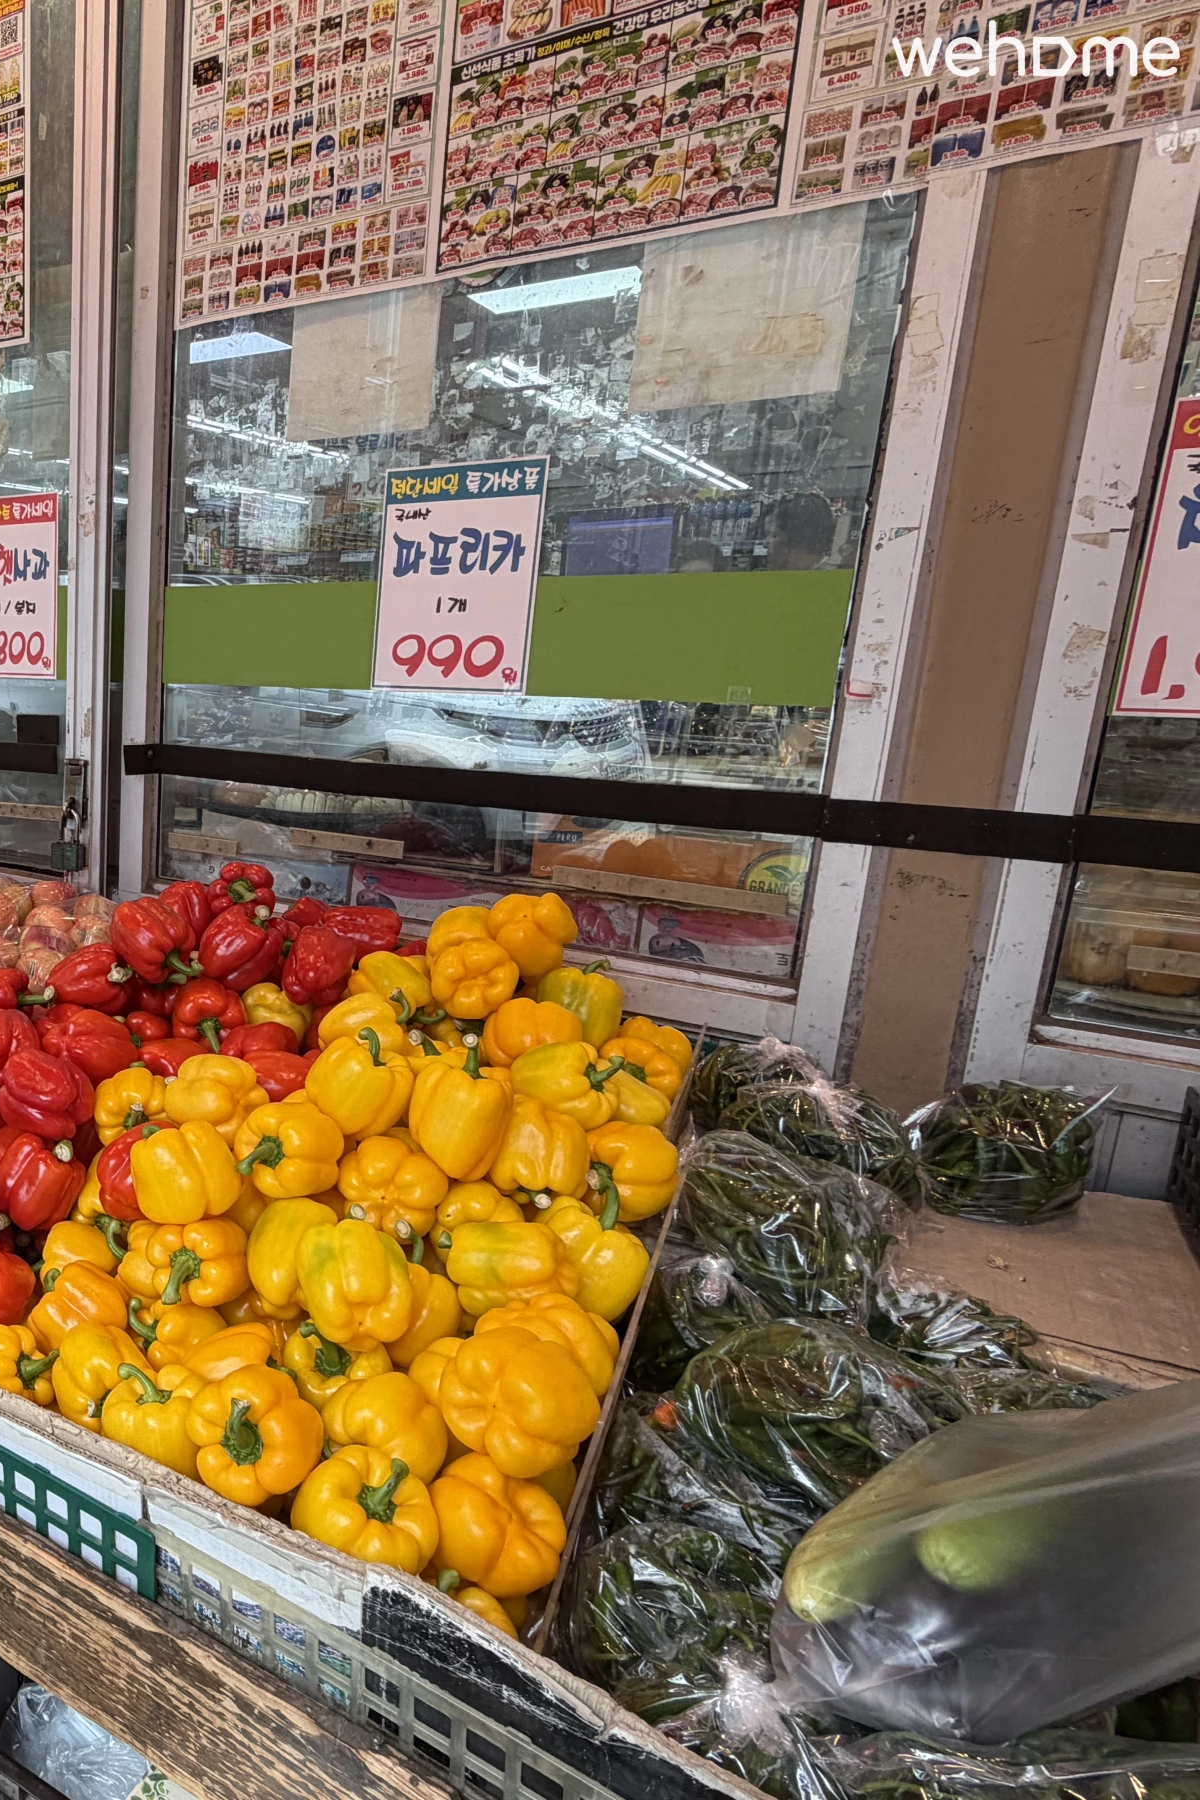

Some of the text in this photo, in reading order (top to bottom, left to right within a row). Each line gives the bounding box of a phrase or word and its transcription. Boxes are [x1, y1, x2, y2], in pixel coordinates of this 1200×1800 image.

[613, 12, 649, 35] 건강한
[390, 466, 542, 499] 전단세일 특가상품
[12, 499, 54, 520] 특가세일
[394, 507, 432, 523] 국내산
[392, 527, 527, 578] 파프리카
[556, 832, 578, 843] PERU
